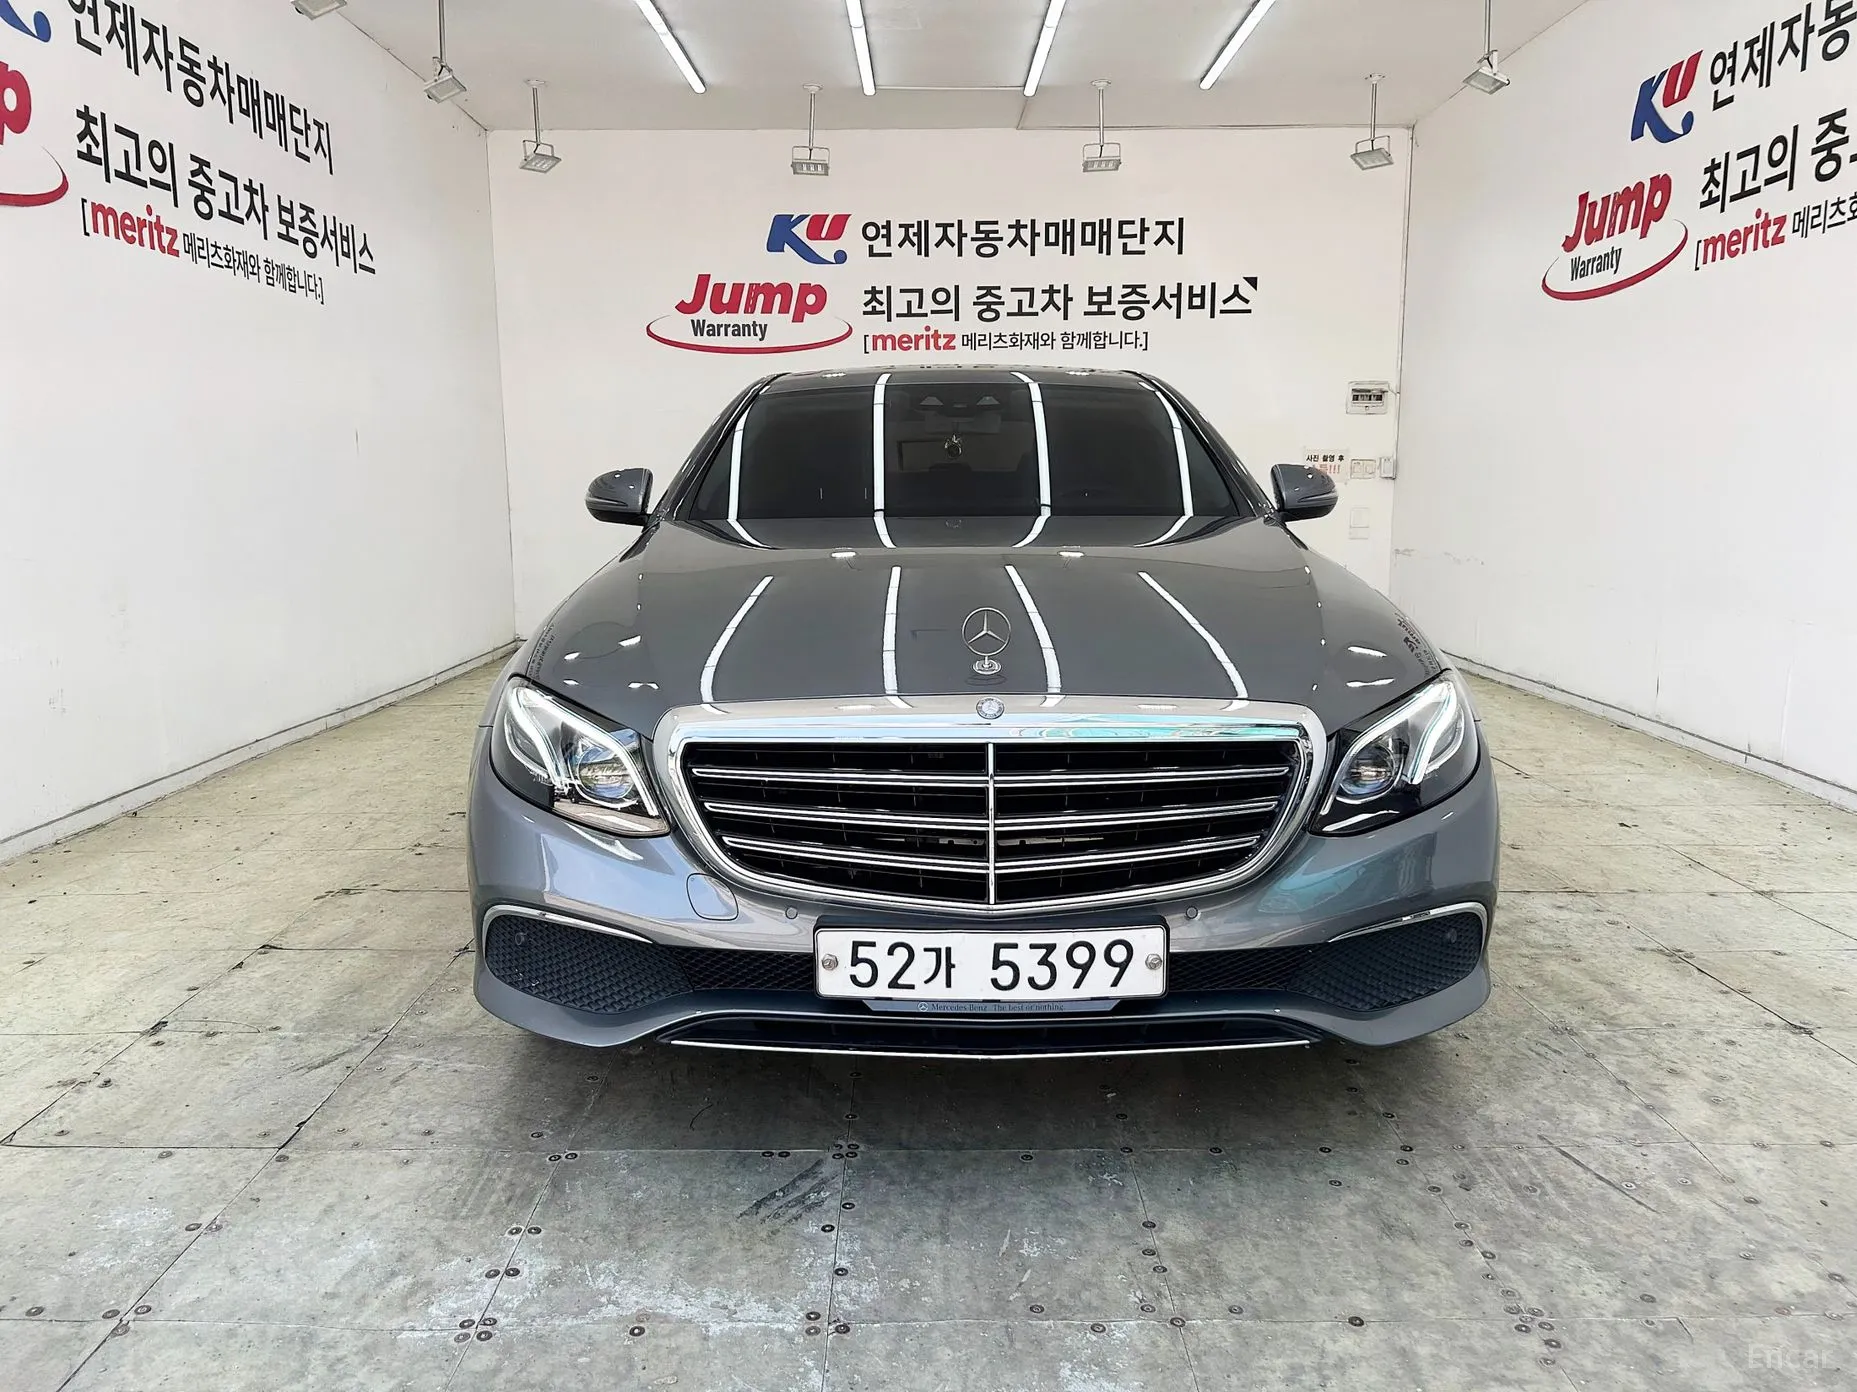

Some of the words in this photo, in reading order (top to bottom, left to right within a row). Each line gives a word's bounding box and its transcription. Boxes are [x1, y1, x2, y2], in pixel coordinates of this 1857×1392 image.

[68, 0, 334, 176] 연제자동차매매단지
[1699, 124, 1799, 214] 최고의
[1811, 108, 1857, 183] 중
[75, 104, 179, 208] 최고의
[188, 153, 269, 241] 중고차
[276, 194, 376, 275] 보증서비스
[1561, 173, 1673, 253] Jump
[182, 233, 261, 283] 메리츠화재와
[861, 217, 1185, 258] 연제자동차매매단지
[1570, 247, 1623, 282] Warranty
[674, 273, 828, 323] Jump
[862, 283, 960, 322] 최고의
[972, 283, 1073, 323] 중고차
[1083, 281, 1253, 321] 보증서비스
[690, 318, 768, 342] Warranty
[961, 331, 1056, 352] 메리츠화재와
[1306, 454, 1319, 462] 사진
[849, 940, 956, 990] 52가
[990, 938, 1134, 991] 5399
